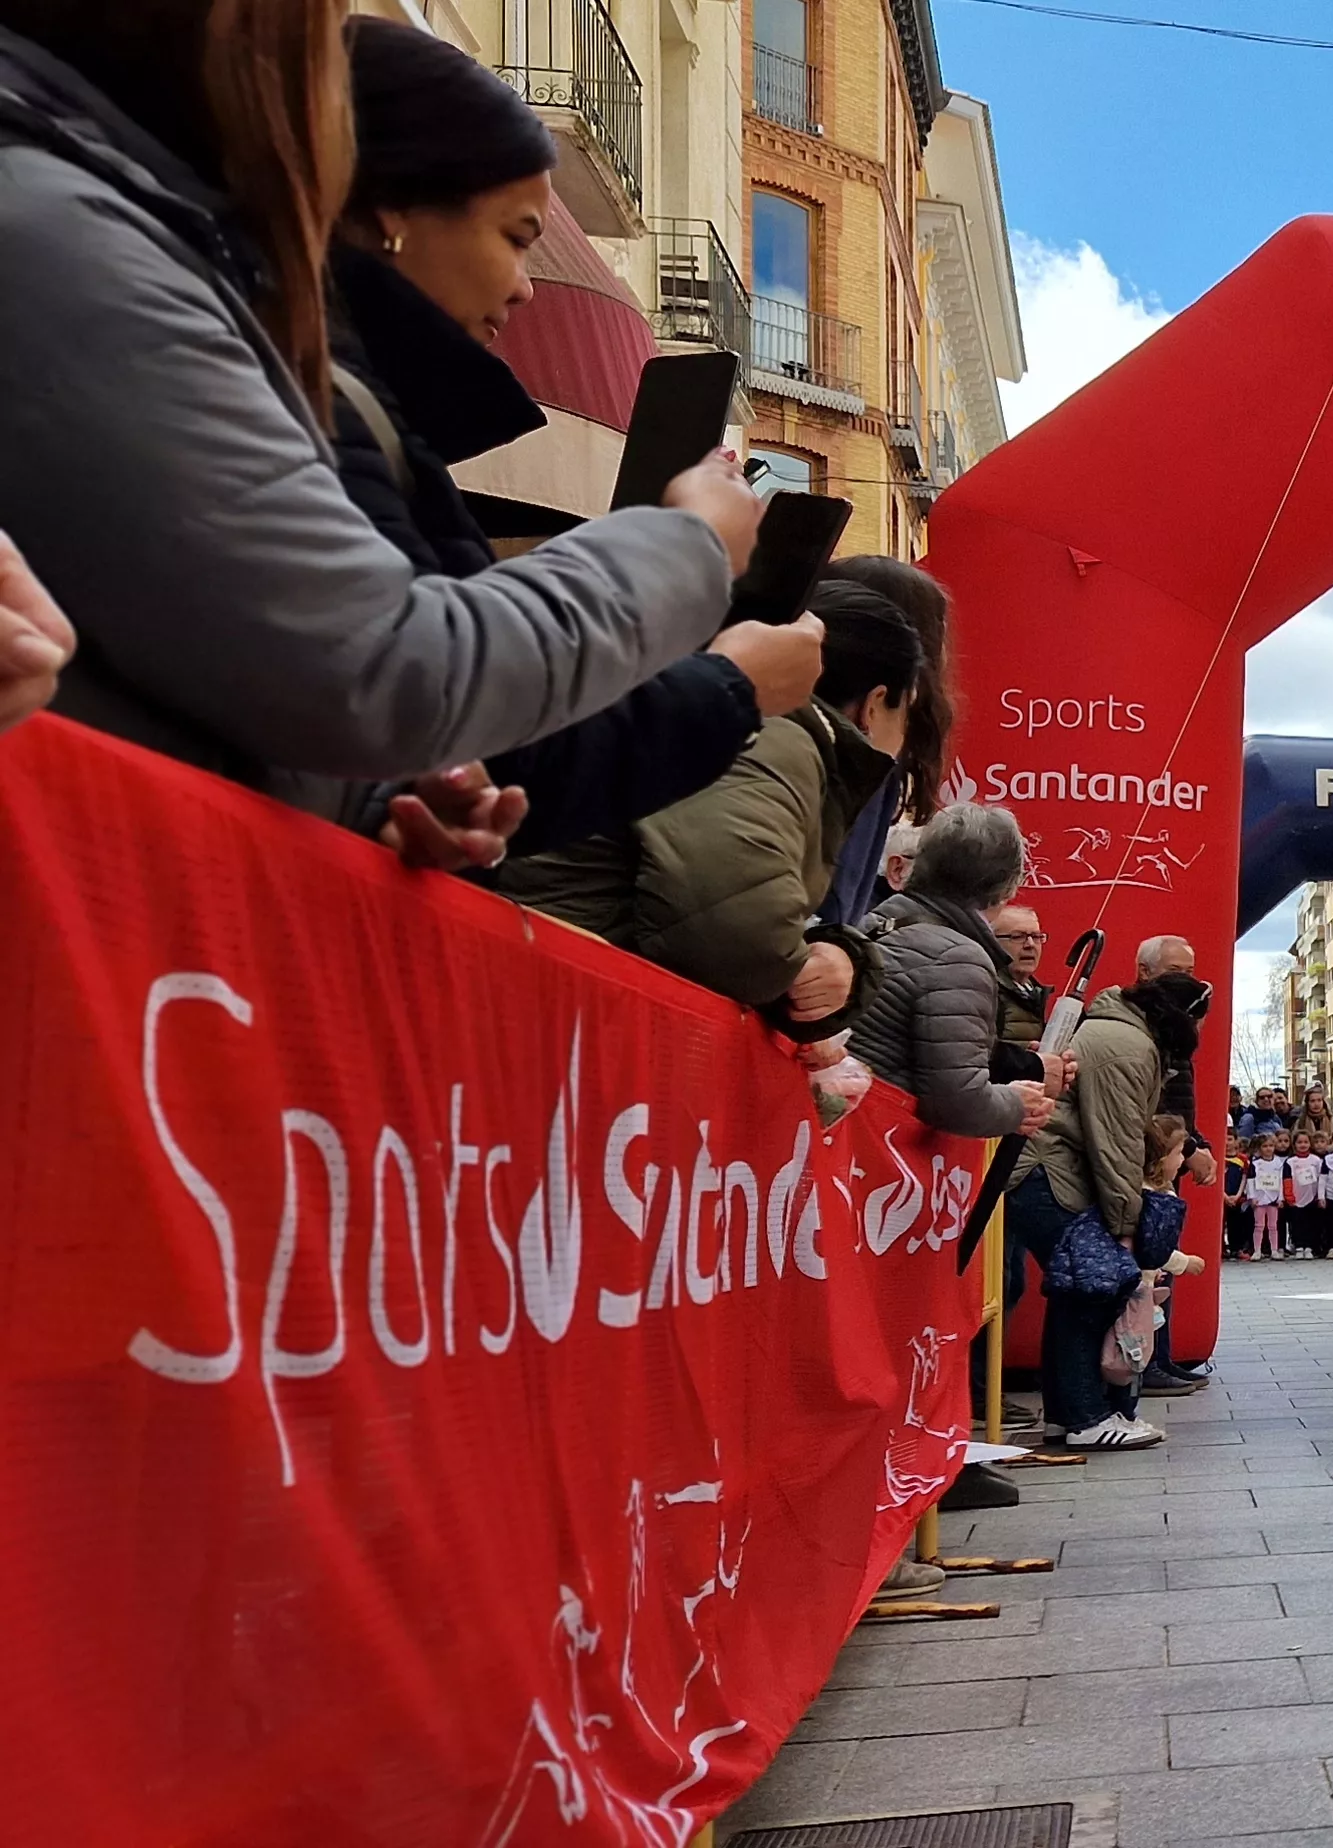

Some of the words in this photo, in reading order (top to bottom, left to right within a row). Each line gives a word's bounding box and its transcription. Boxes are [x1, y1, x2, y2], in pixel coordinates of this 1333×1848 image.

[1000, 688, 1145, 737] Sports
[985, 763, 1208, 811] Santander
[127, 972, 517, 1486] Sports
